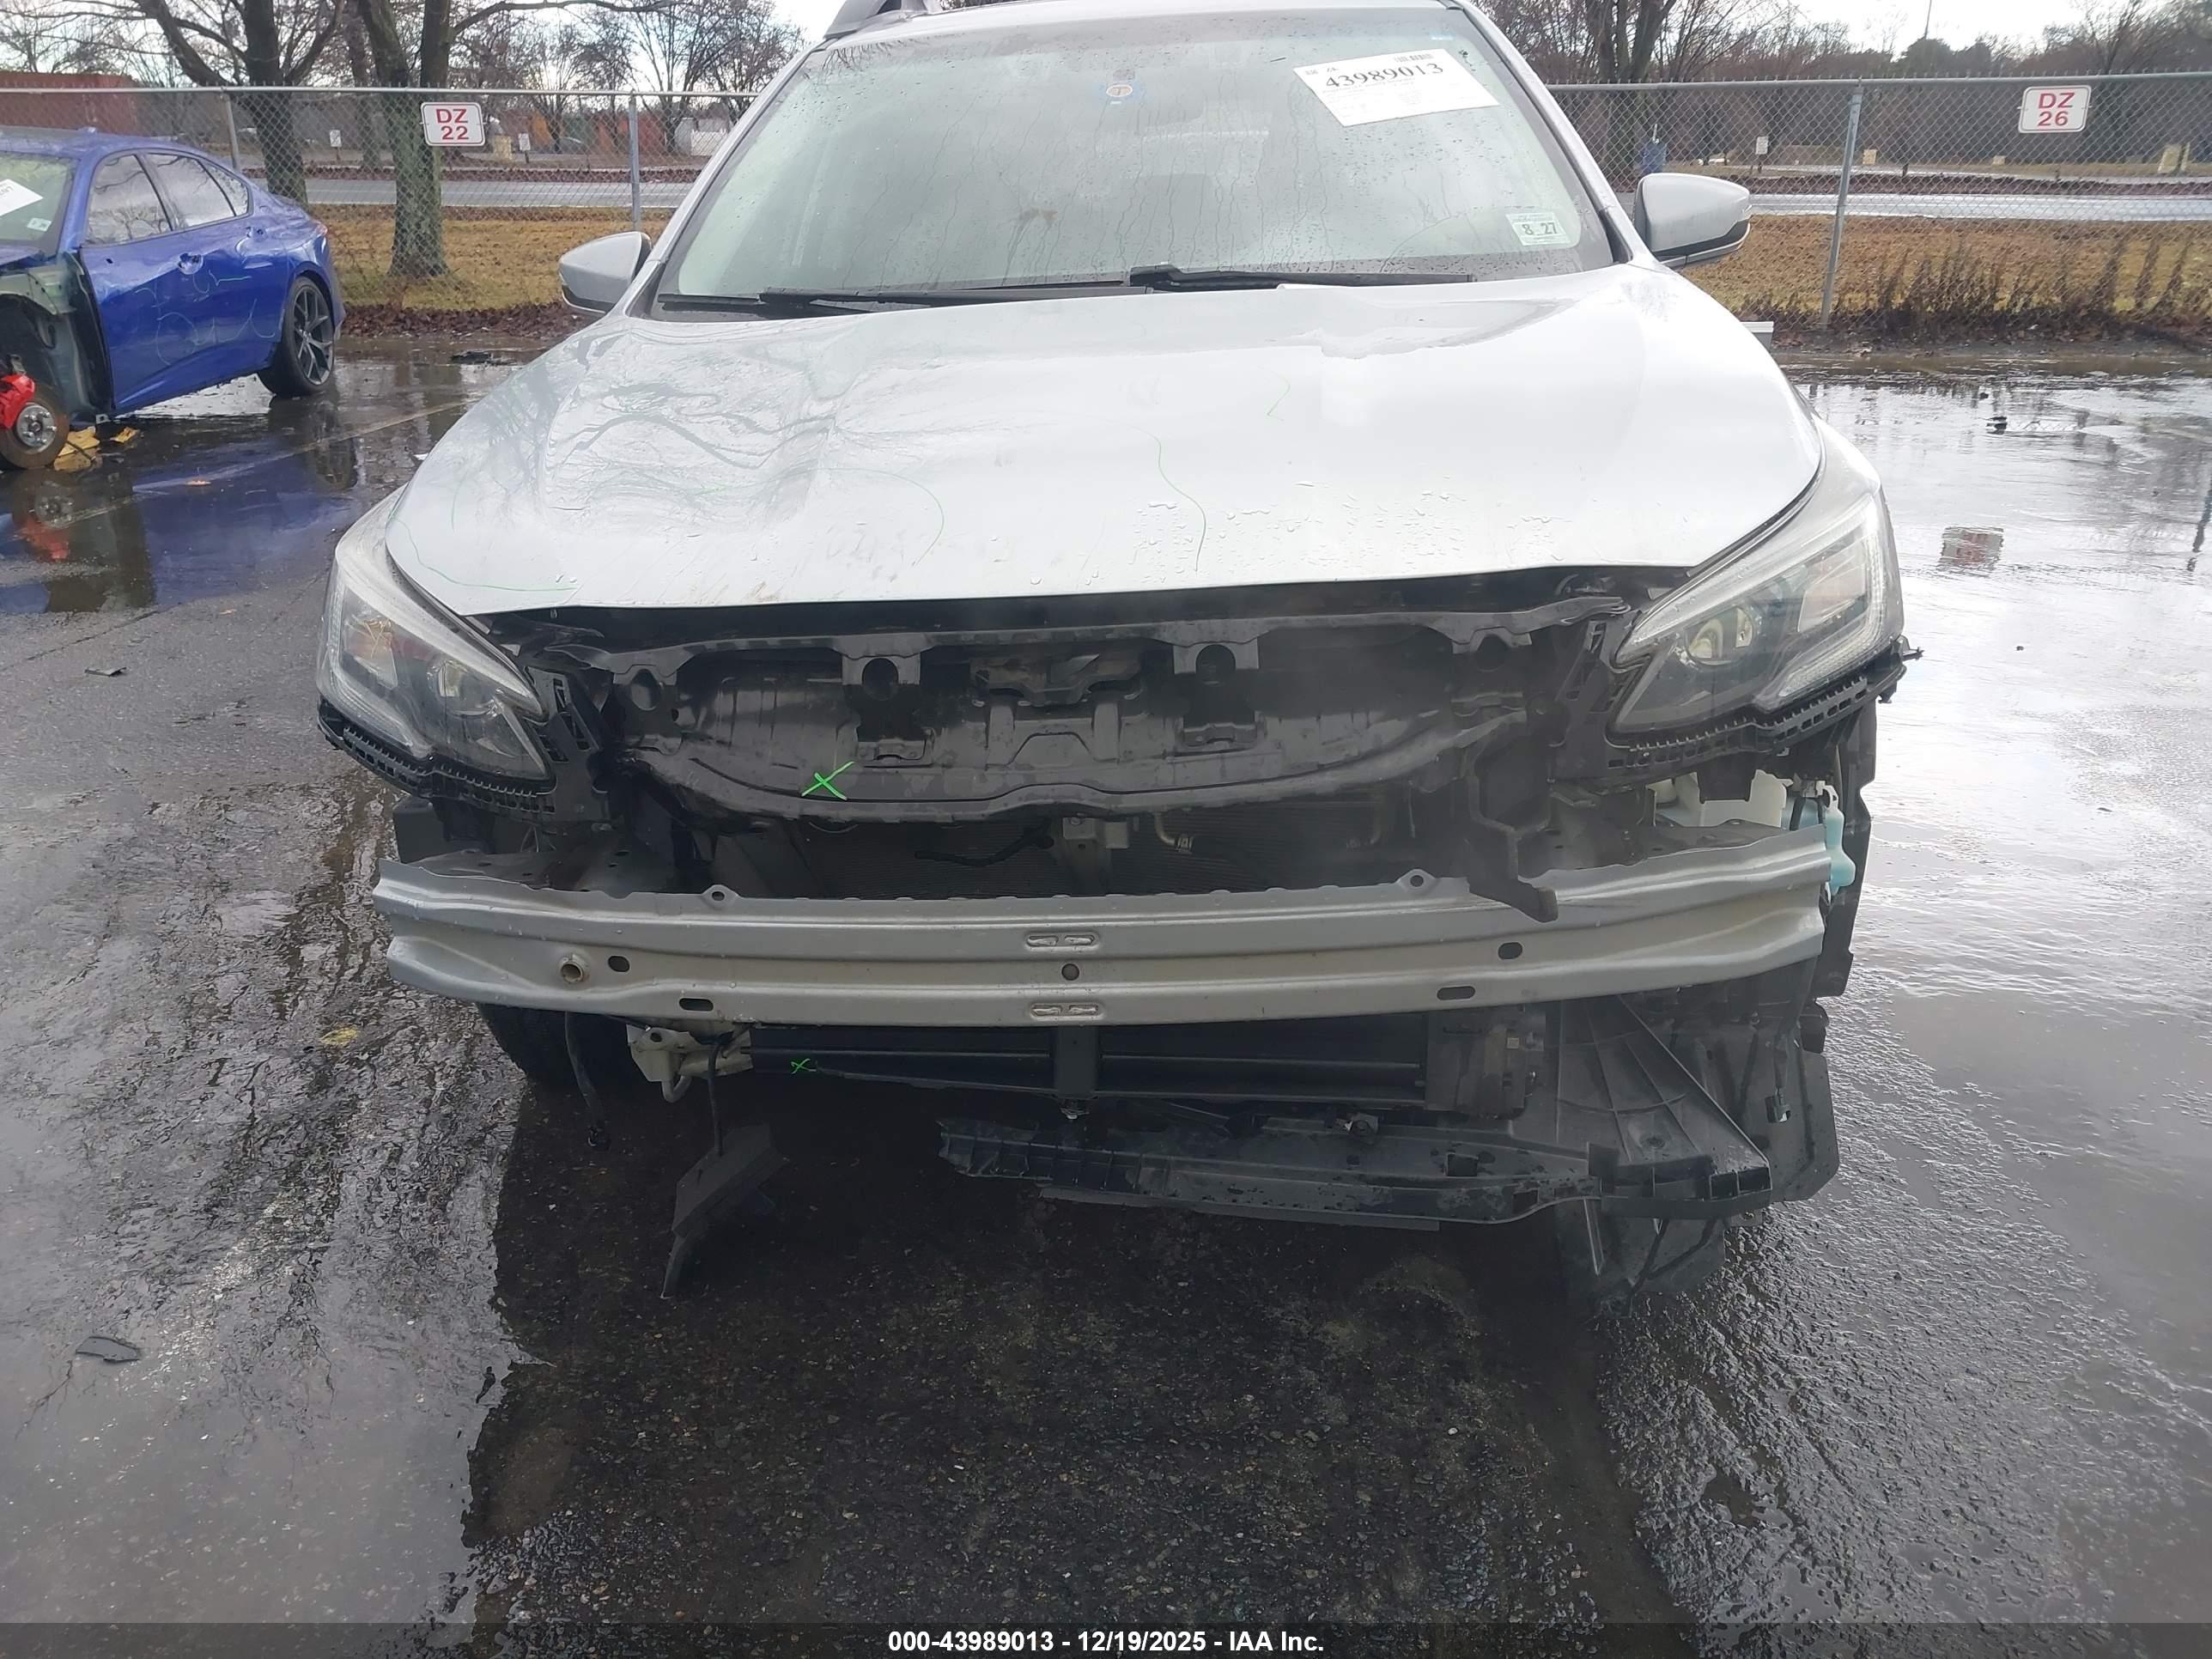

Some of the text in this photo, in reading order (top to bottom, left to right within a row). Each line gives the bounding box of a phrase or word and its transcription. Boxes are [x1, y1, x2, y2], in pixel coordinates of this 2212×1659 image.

[1325, 63, 1444, 88] 43989013
[2039, 92, 2075, 109] DZ
[435, 108, 469, 124] DZ
[2038, 111, 2069, 126] 26
[441, 125, 469, 140] 22
[1522, 222, 1558, 235] 8 27
